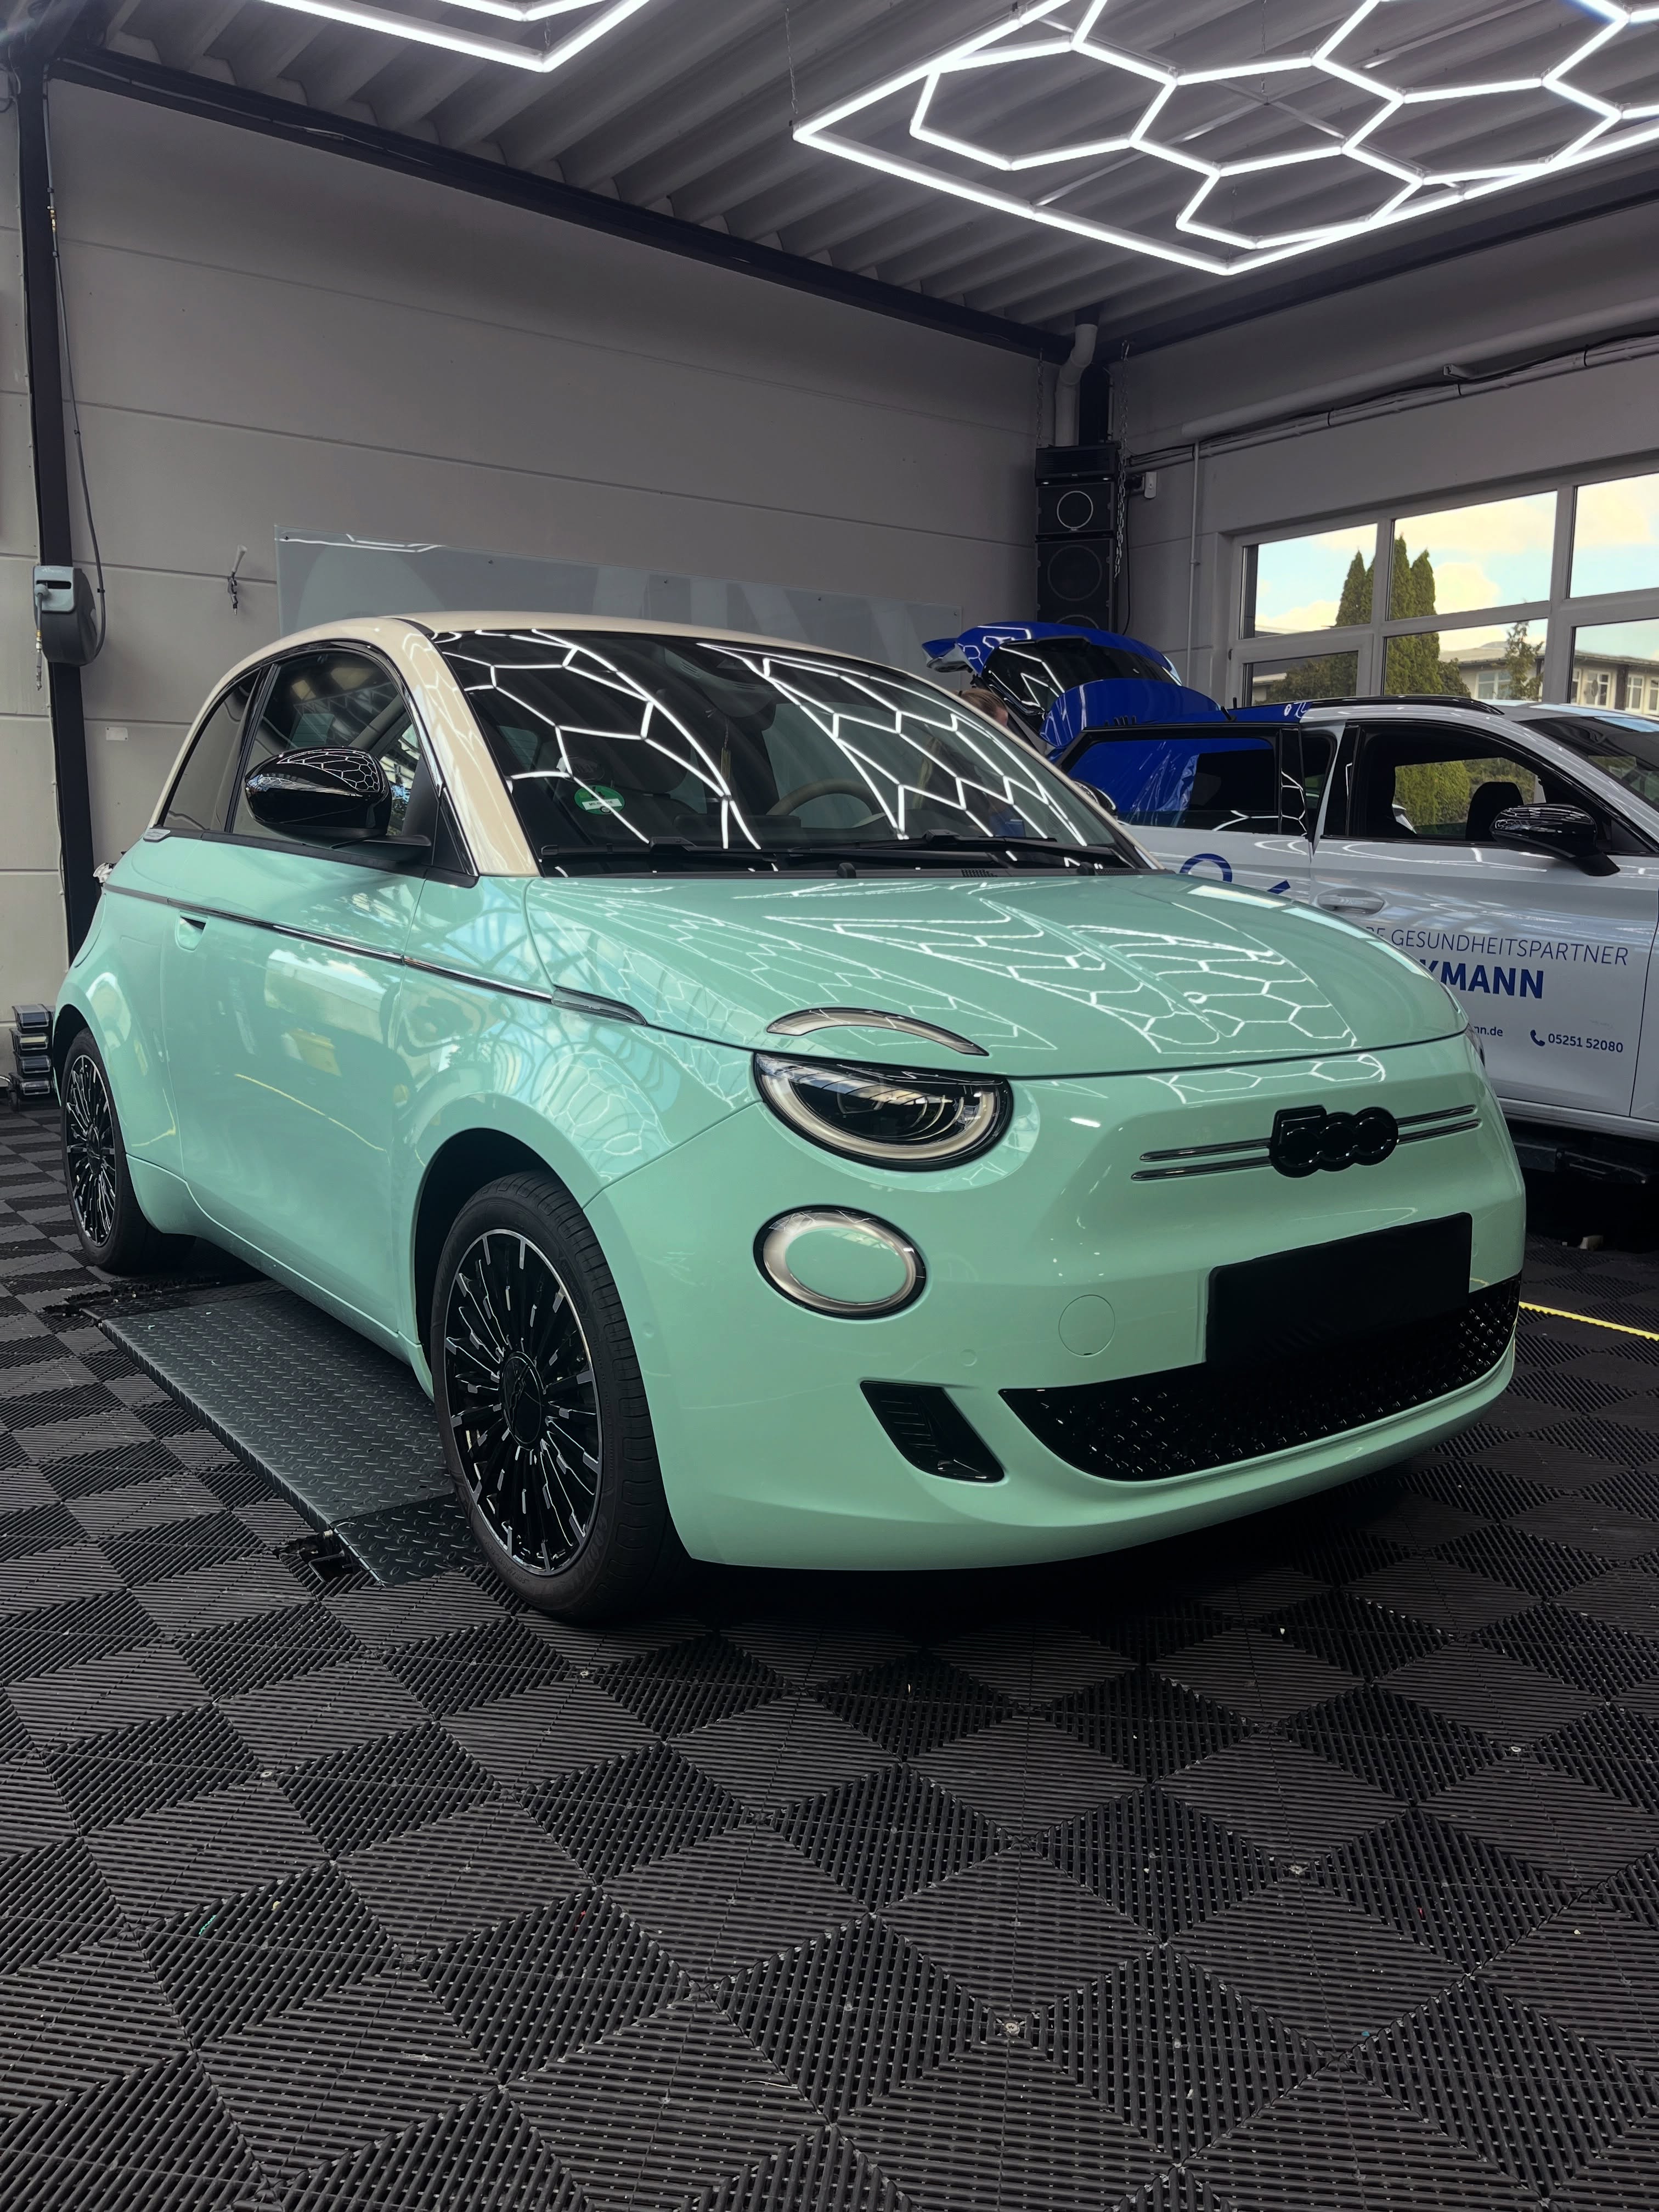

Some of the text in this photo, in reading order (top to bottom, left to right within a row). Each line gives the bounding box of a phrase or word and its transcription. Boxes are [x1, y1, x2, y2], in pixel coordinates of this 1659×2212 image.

[1391, 929, 1628, 966] GESUNDHEITSPARTNER
[1548, 1033, 1623, 1053] 05251 52080
[1268, 1105, 1398, 1178] 500
